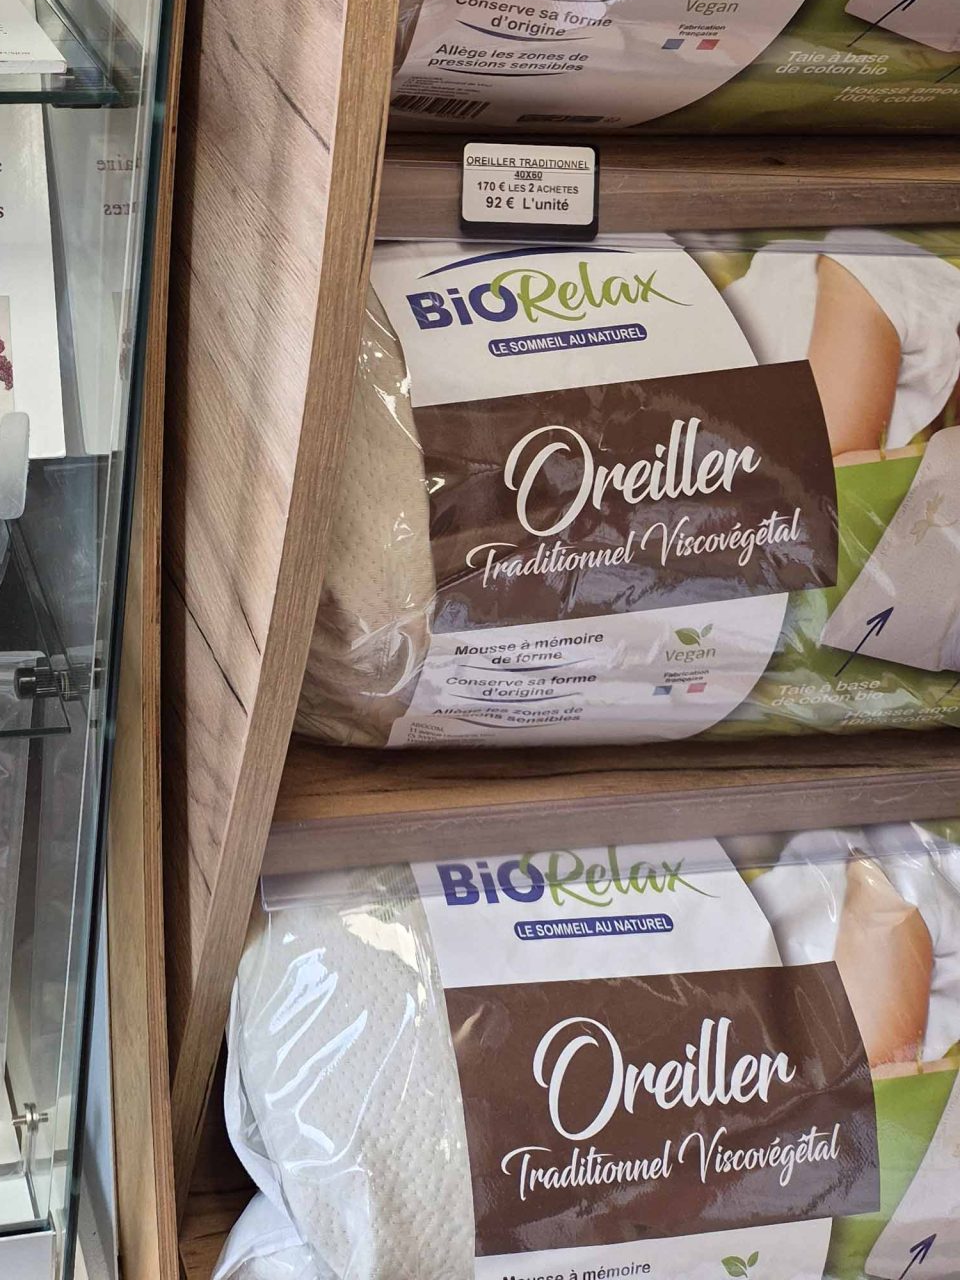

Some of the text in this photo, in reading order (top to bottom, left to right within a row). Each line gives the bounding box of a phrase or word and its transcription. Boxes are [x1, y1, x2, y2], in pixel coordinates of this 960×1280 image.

[538, 7, 559, 19] sa
[563, 12, 613, 29] forme
[685, 0, 739, 15] Vegan
[490, 15, 567, 37] d'origine
[466, 156, 590, 169] OREILLER TRADITIONNEL
[514, 170, 543, 179] 40X60
[477, 181, 496, 192] 170
[508, 184, 526, 192] LES
[536, 185, 579, 195] ACHETES
[486, 196, 570, 211] 92 € L'unité
[504, 417, 762, 537] Oreiller
[466, 531, 635, 590] Traditionnel
[517, 916, 672, 939] LE SOMMEIL AU NATUREL
[533, 1016, 797, 1141] Oreiller
[501, 1140, 673, 1203] Traditionnel
